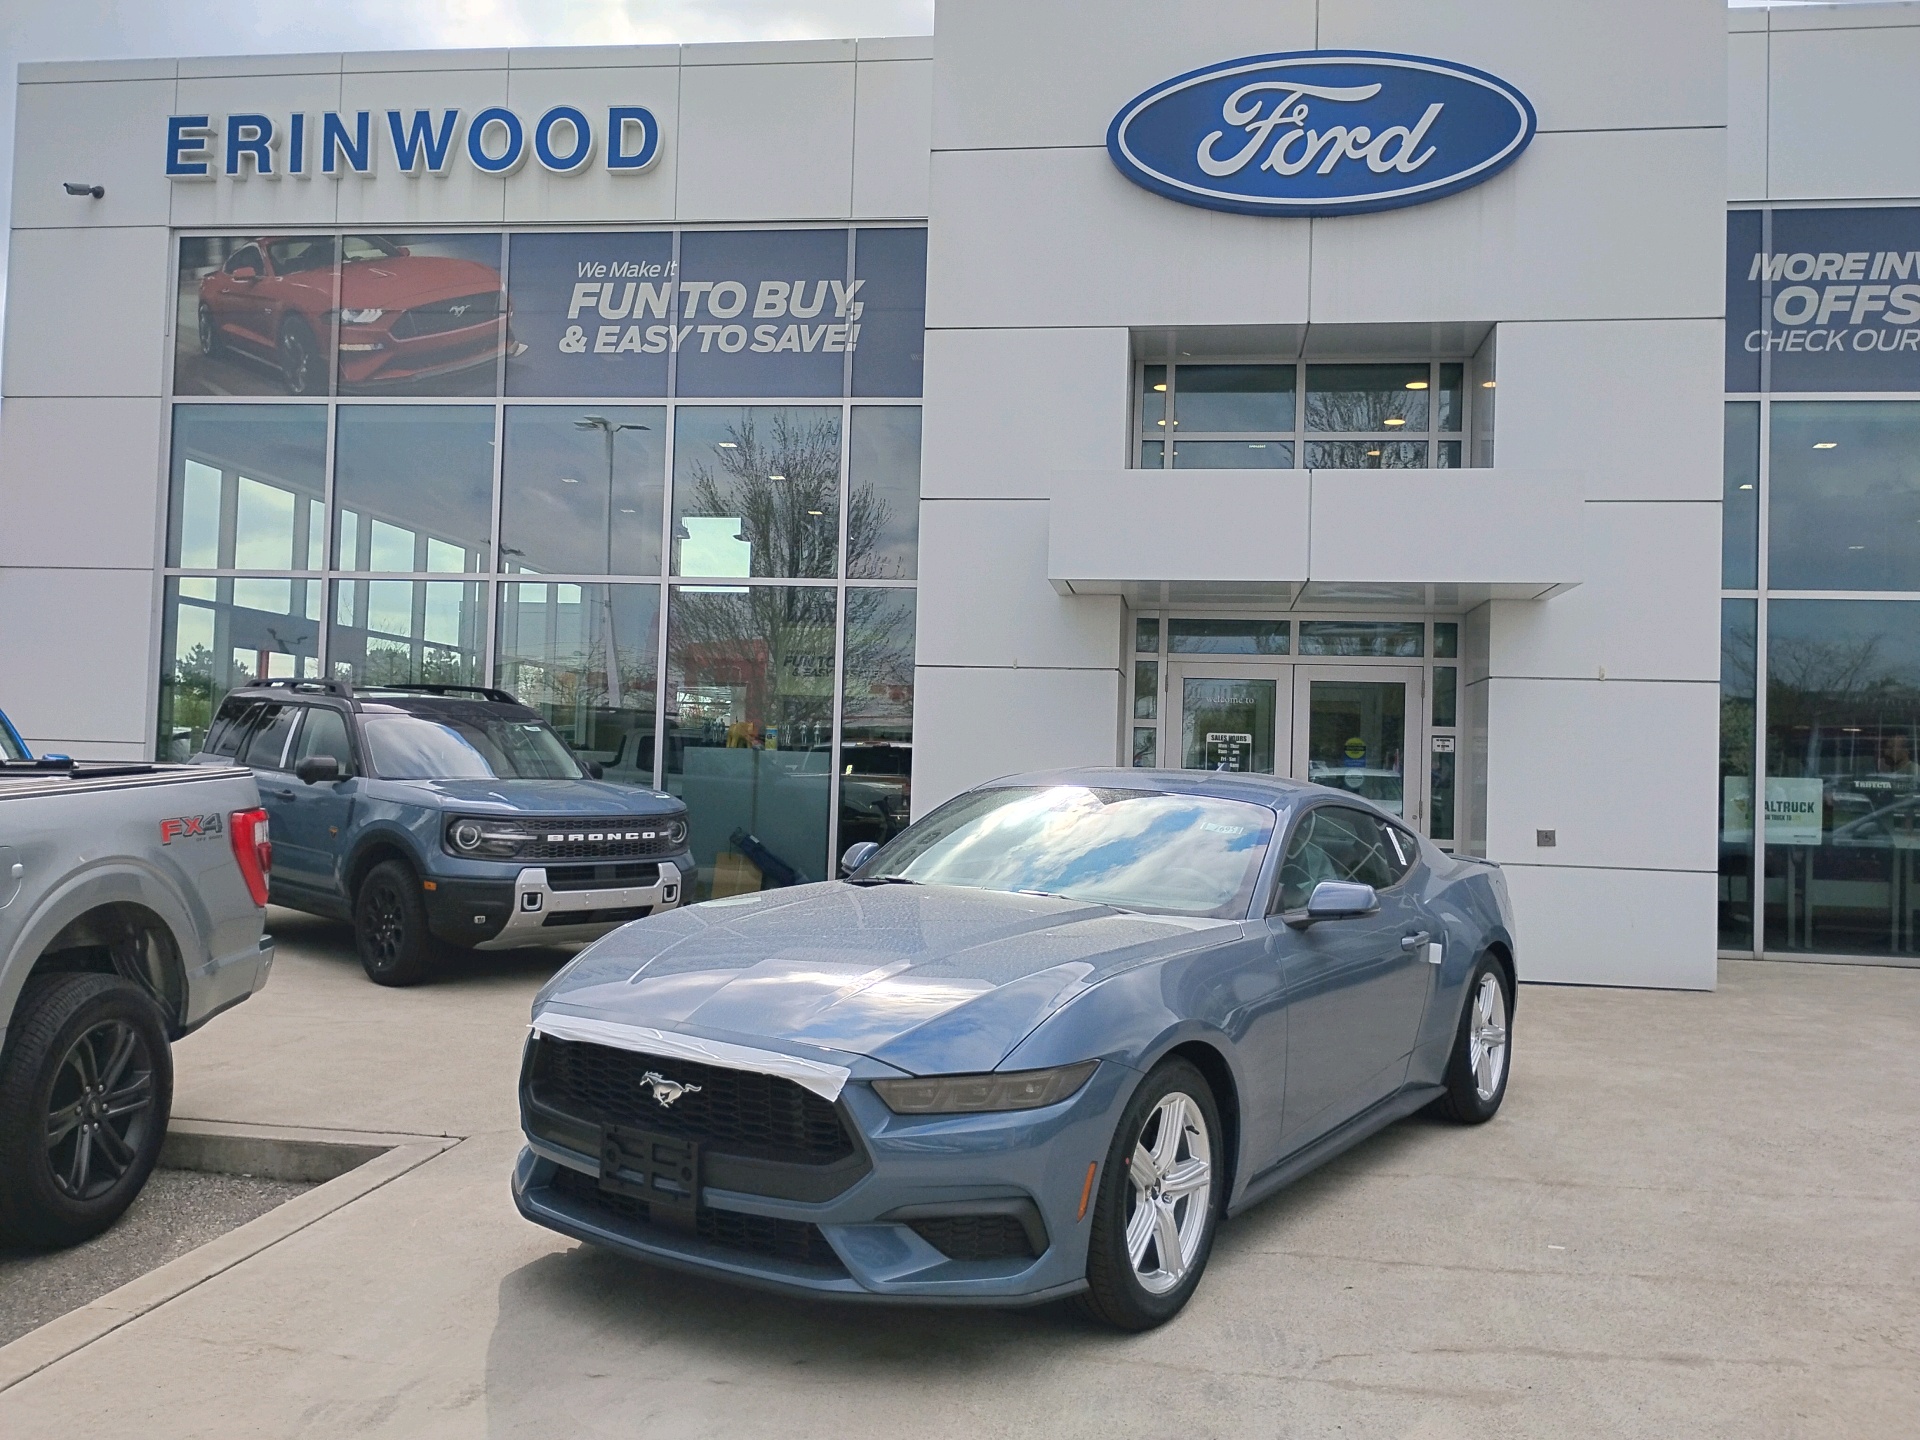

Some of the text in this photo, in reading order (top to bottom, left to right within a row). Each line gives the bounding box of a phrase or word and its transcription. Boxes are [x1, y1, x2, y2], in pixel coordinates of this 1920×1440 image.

[165, 105, 662, 179] ERINWOOD
[1197, 81, 1444, 177] Ford
[577, 260, 678, 278] We Make It
[1748, 252, 1870, 281] MORE
[567, 280, 866, 321] FUN TO BUY,
[559, 323, 861, 353] & EASY TO SAVE!
[1744, 328, 1920, 352] CHECK OUR
[1206, 695, 1243, 704] welcome
[1764, 800, 1815, 813] ALTRUCK
[159, 812, 223, 847] FX4
[547, 831, 656, 842] BRONCO
